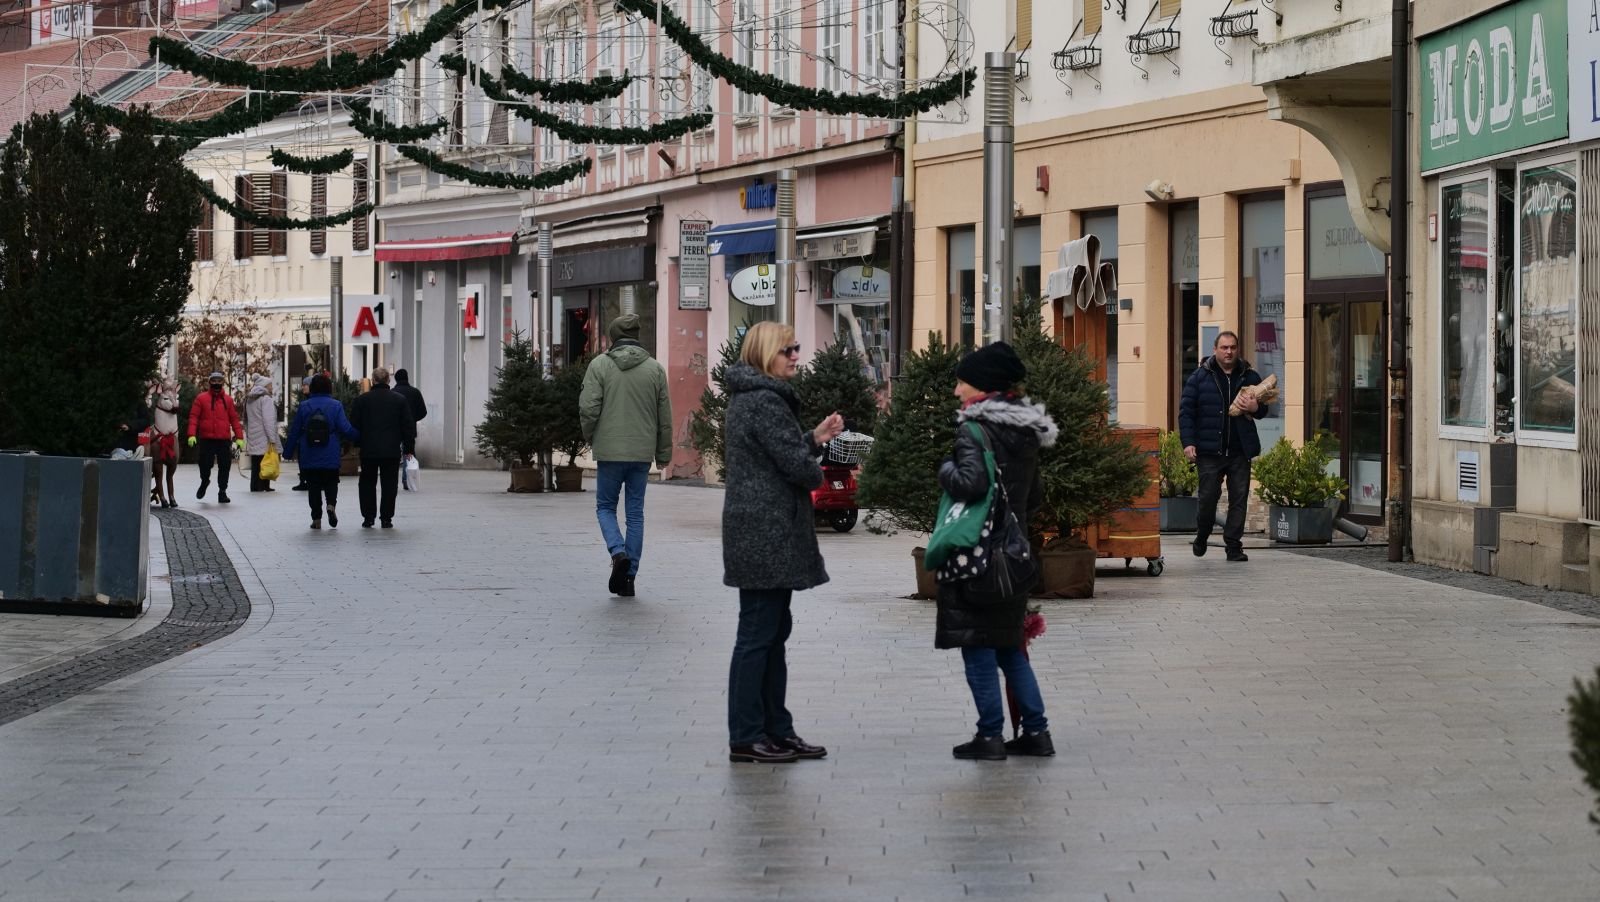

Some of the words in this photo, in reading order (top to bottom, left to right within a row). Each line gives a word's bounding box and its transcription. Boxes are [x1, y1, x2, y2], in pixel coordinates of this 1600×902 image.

[54, 6, 84, 31] triglav
[1429, 13, 1554, 148] MODA
[683, 223, 706, 231] EXPRES
[352, 302, 384, 337] A1
